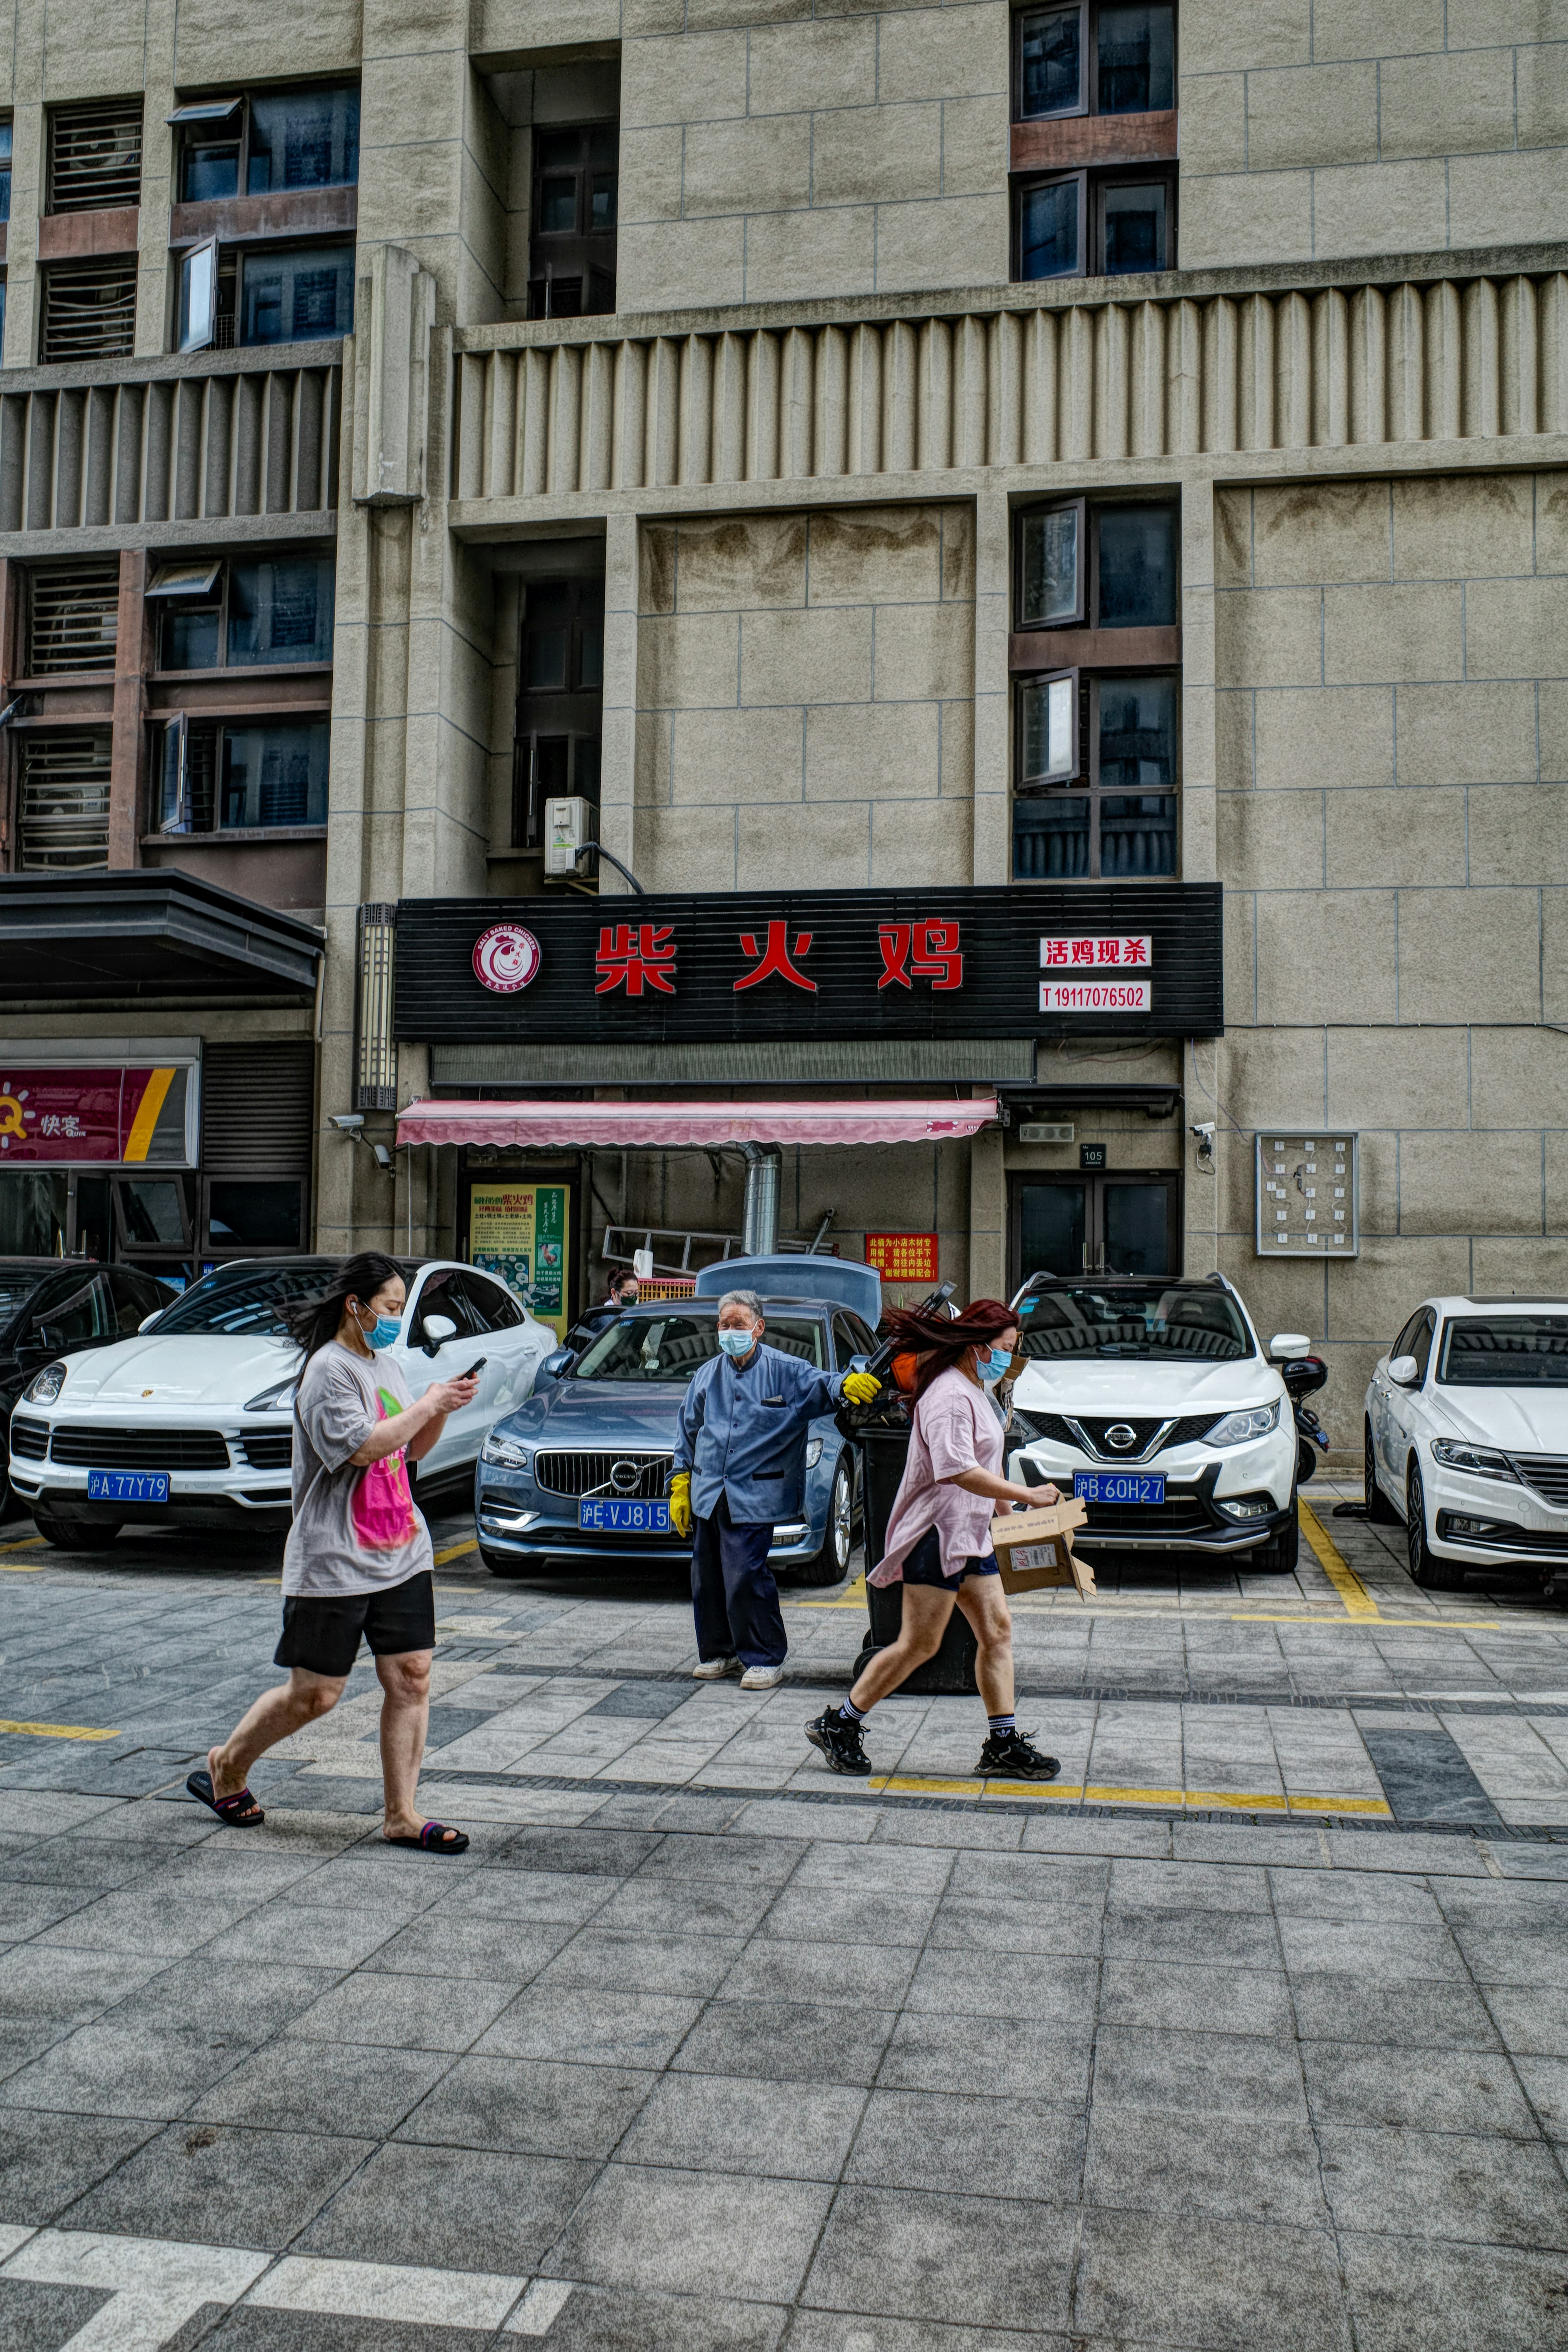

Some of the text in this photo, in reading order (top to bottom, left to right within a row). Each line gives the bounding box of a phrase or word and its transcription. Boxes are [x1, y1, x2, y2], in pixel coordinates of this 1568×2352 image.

[477, 925, 537, 951] SALT BAKED CHICKEN
[595, 918, 963, 996] 柴火鸡
[1046, 939, 1146, 965] 活鸡现杀
[41, 1114, 80, 1136] 快客
[1084, 1151, 1102, 1161] 105
[870, 1238, 931, 1247] 此桶为小店木材专
[870, 1248, 931, 1257] 用桶，请各位手下
[870, 1258, 931, 1268] 留情，勿往内丢垃
